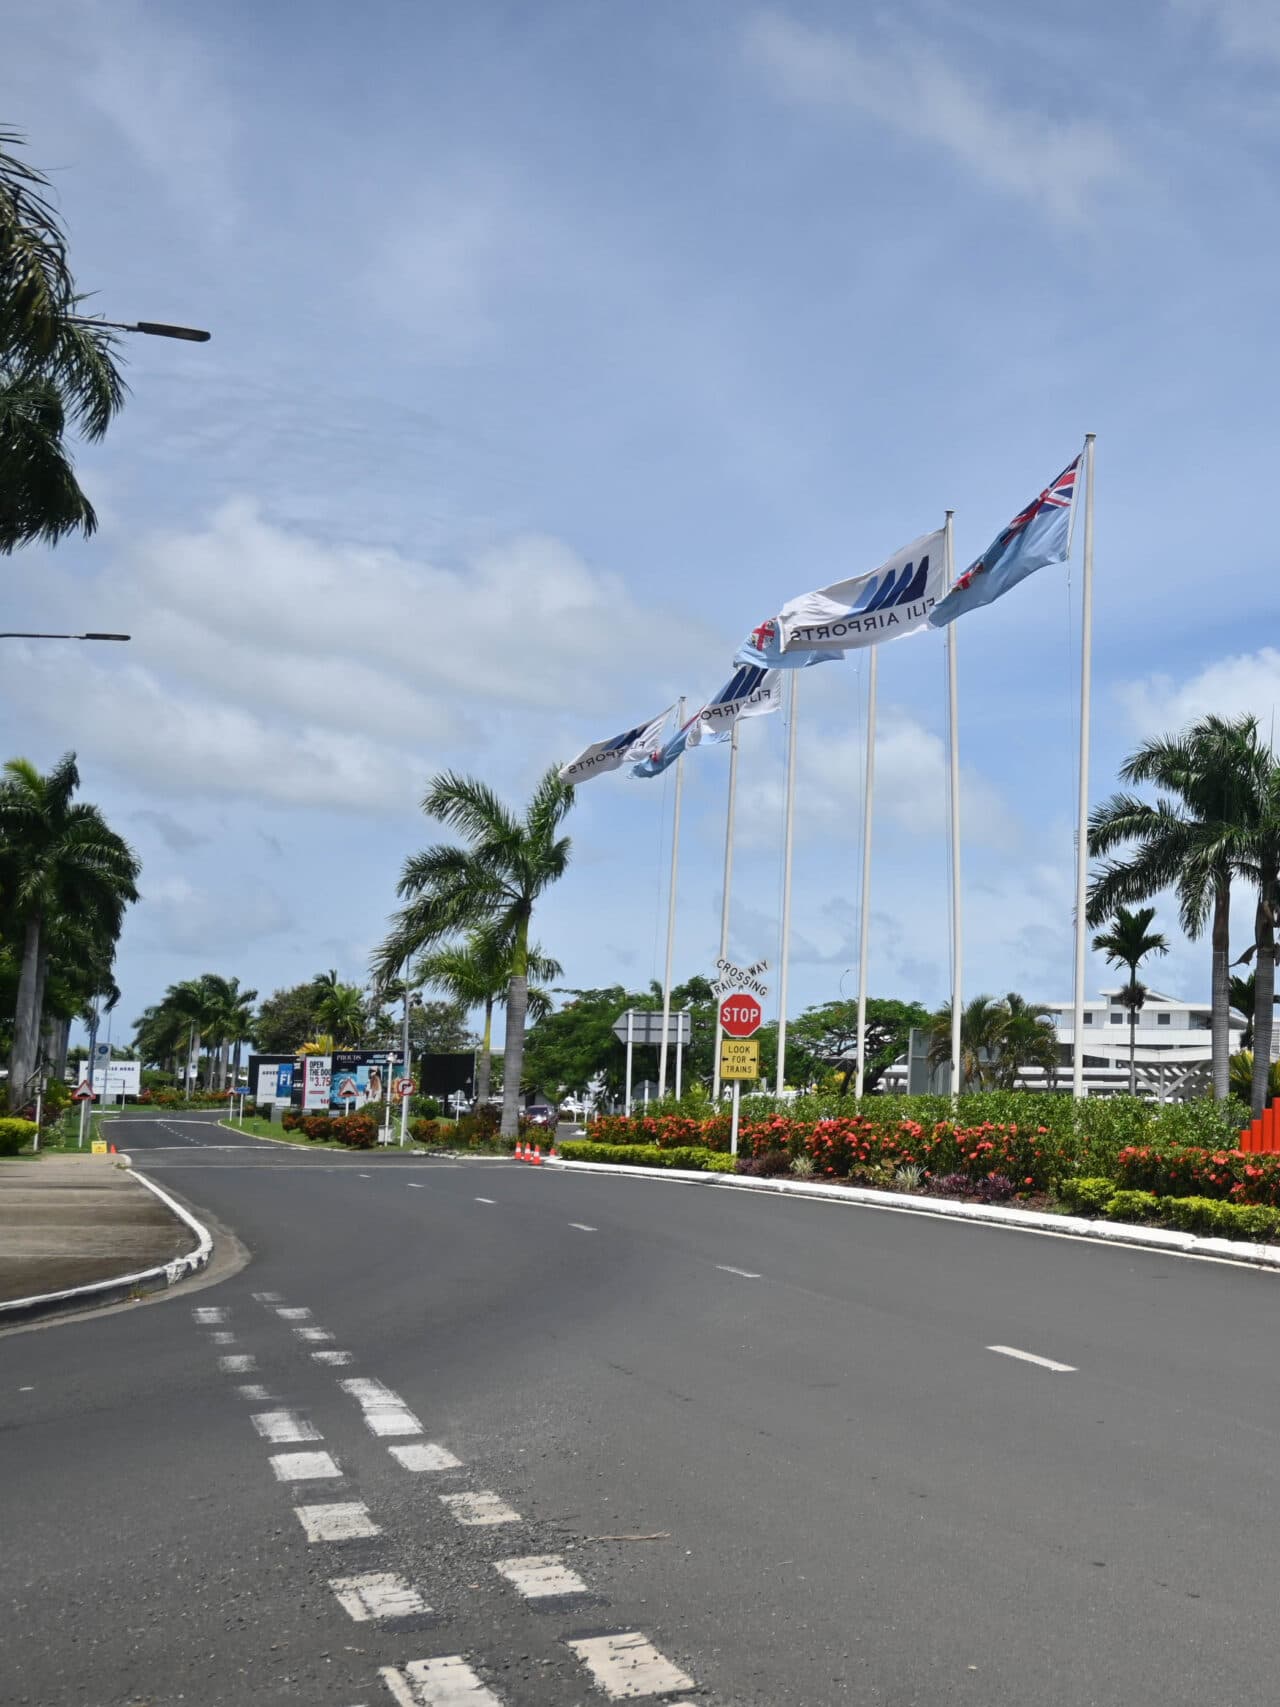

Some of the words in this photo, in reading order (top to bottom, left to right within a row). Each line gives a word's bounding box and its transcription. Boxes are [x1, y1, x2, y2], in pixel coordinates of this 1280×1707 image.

[714, 978, 737, 995] RAIL
[748, 960, 769, 977] WAY
[716, 959, 768, 997] CROSSING
[722, 1007, 759, 1023] STOP
[728, 1046, 751, 1054] LOOK
[309, 1060, 324, 1069] OPEN
[726, 1065, 752, 1074] TRAINS
